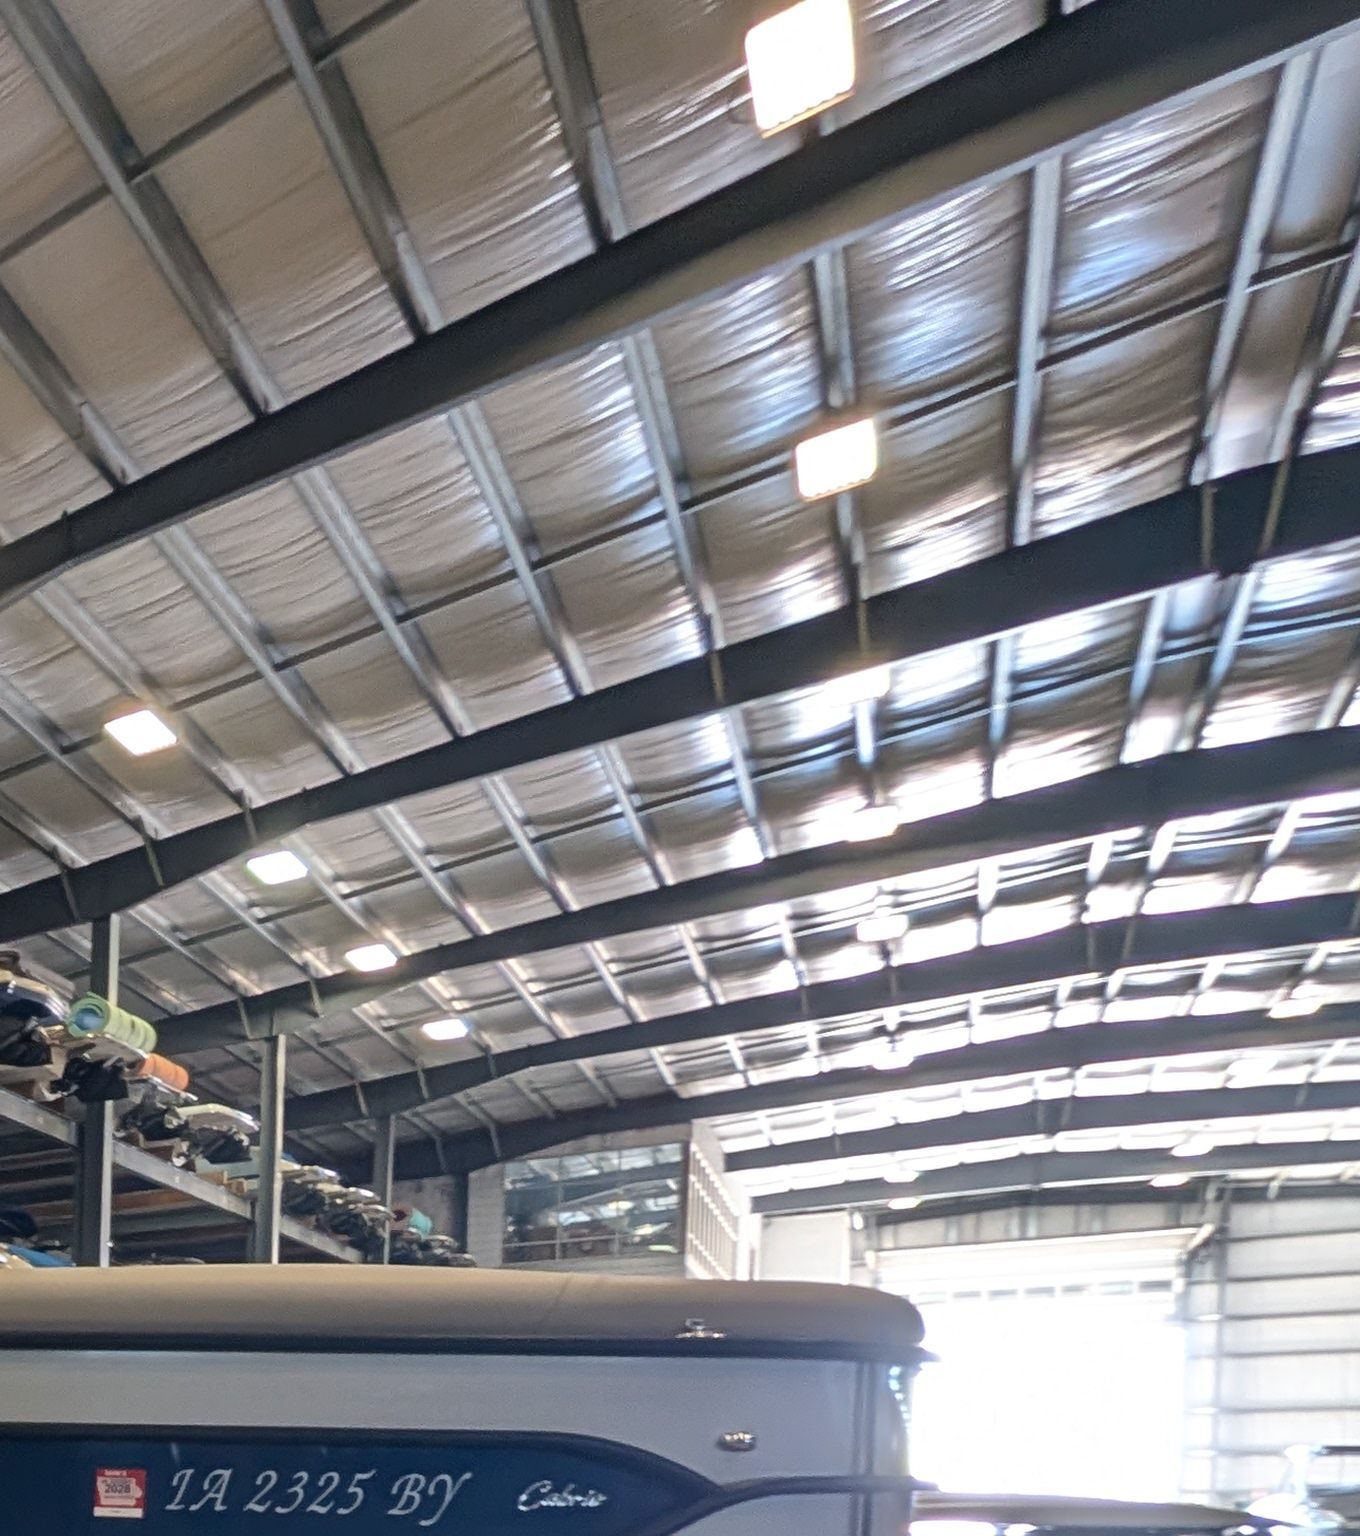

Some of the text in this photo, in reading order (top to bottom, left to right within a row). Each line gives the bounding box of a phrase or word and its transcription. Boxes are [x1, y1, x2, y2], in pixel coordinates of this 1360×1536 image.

[165, 1468, 473, 1527] IA 2325 BY
[518, 1480, 608, 1511] Cabrio
